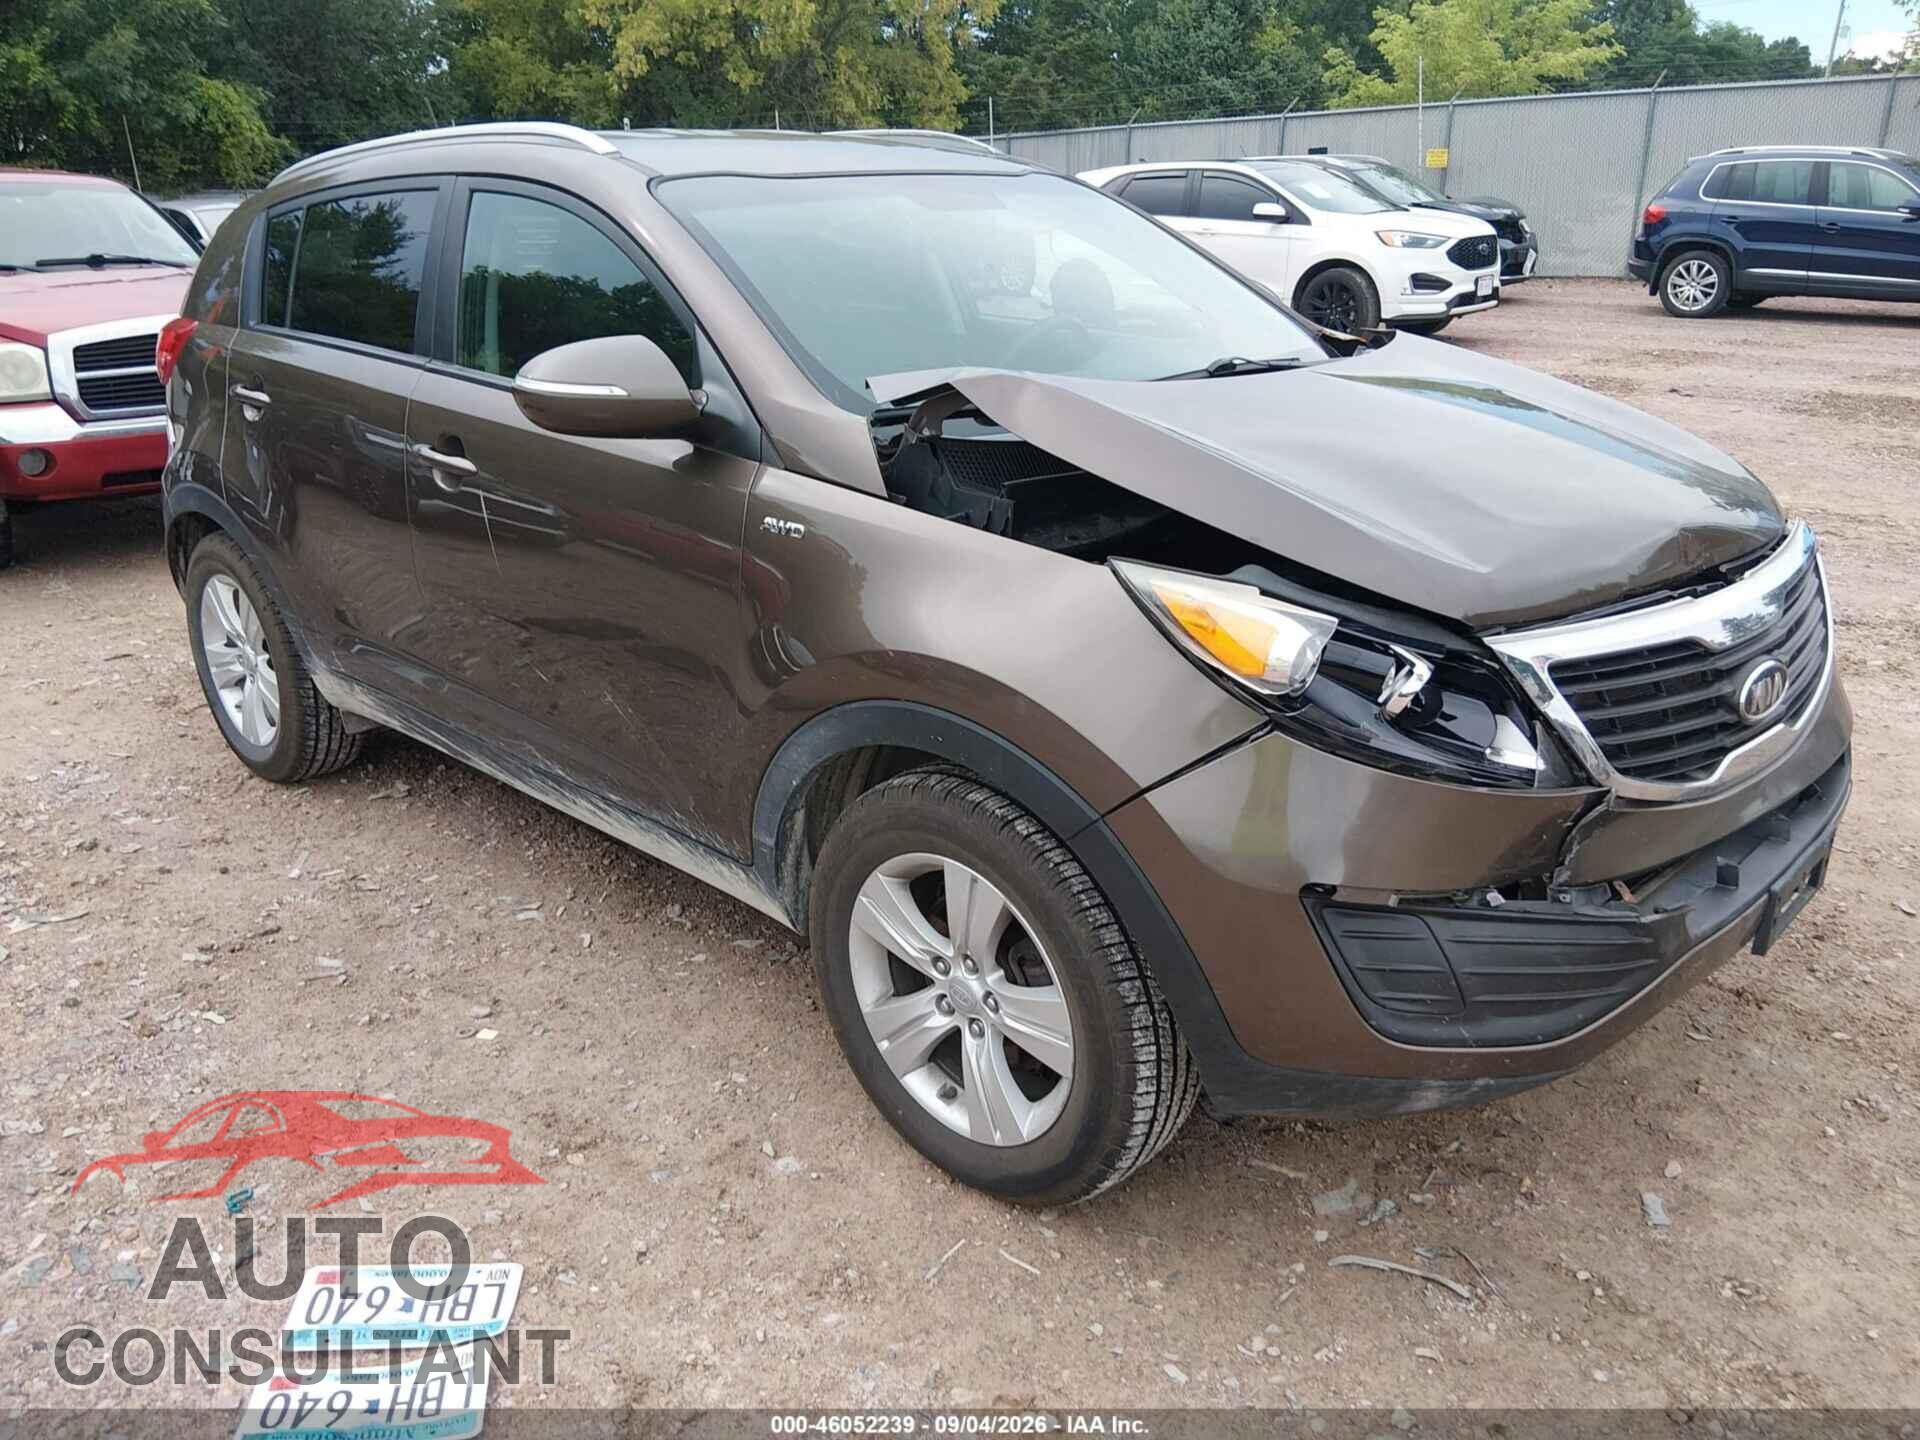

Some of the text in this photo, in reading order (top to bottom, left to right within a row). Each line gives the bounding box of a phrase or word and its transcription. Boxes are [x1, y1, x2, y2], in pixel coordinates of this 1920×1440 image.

[760, 516, 805, 539] AWD
[1750, 671, 1783, 715] KIA
[486, 1268, 511, 1281] NOV
[305, 1283, 507, 1325] LBH 640
[259, 1367, 476, 1430] LBH 640
